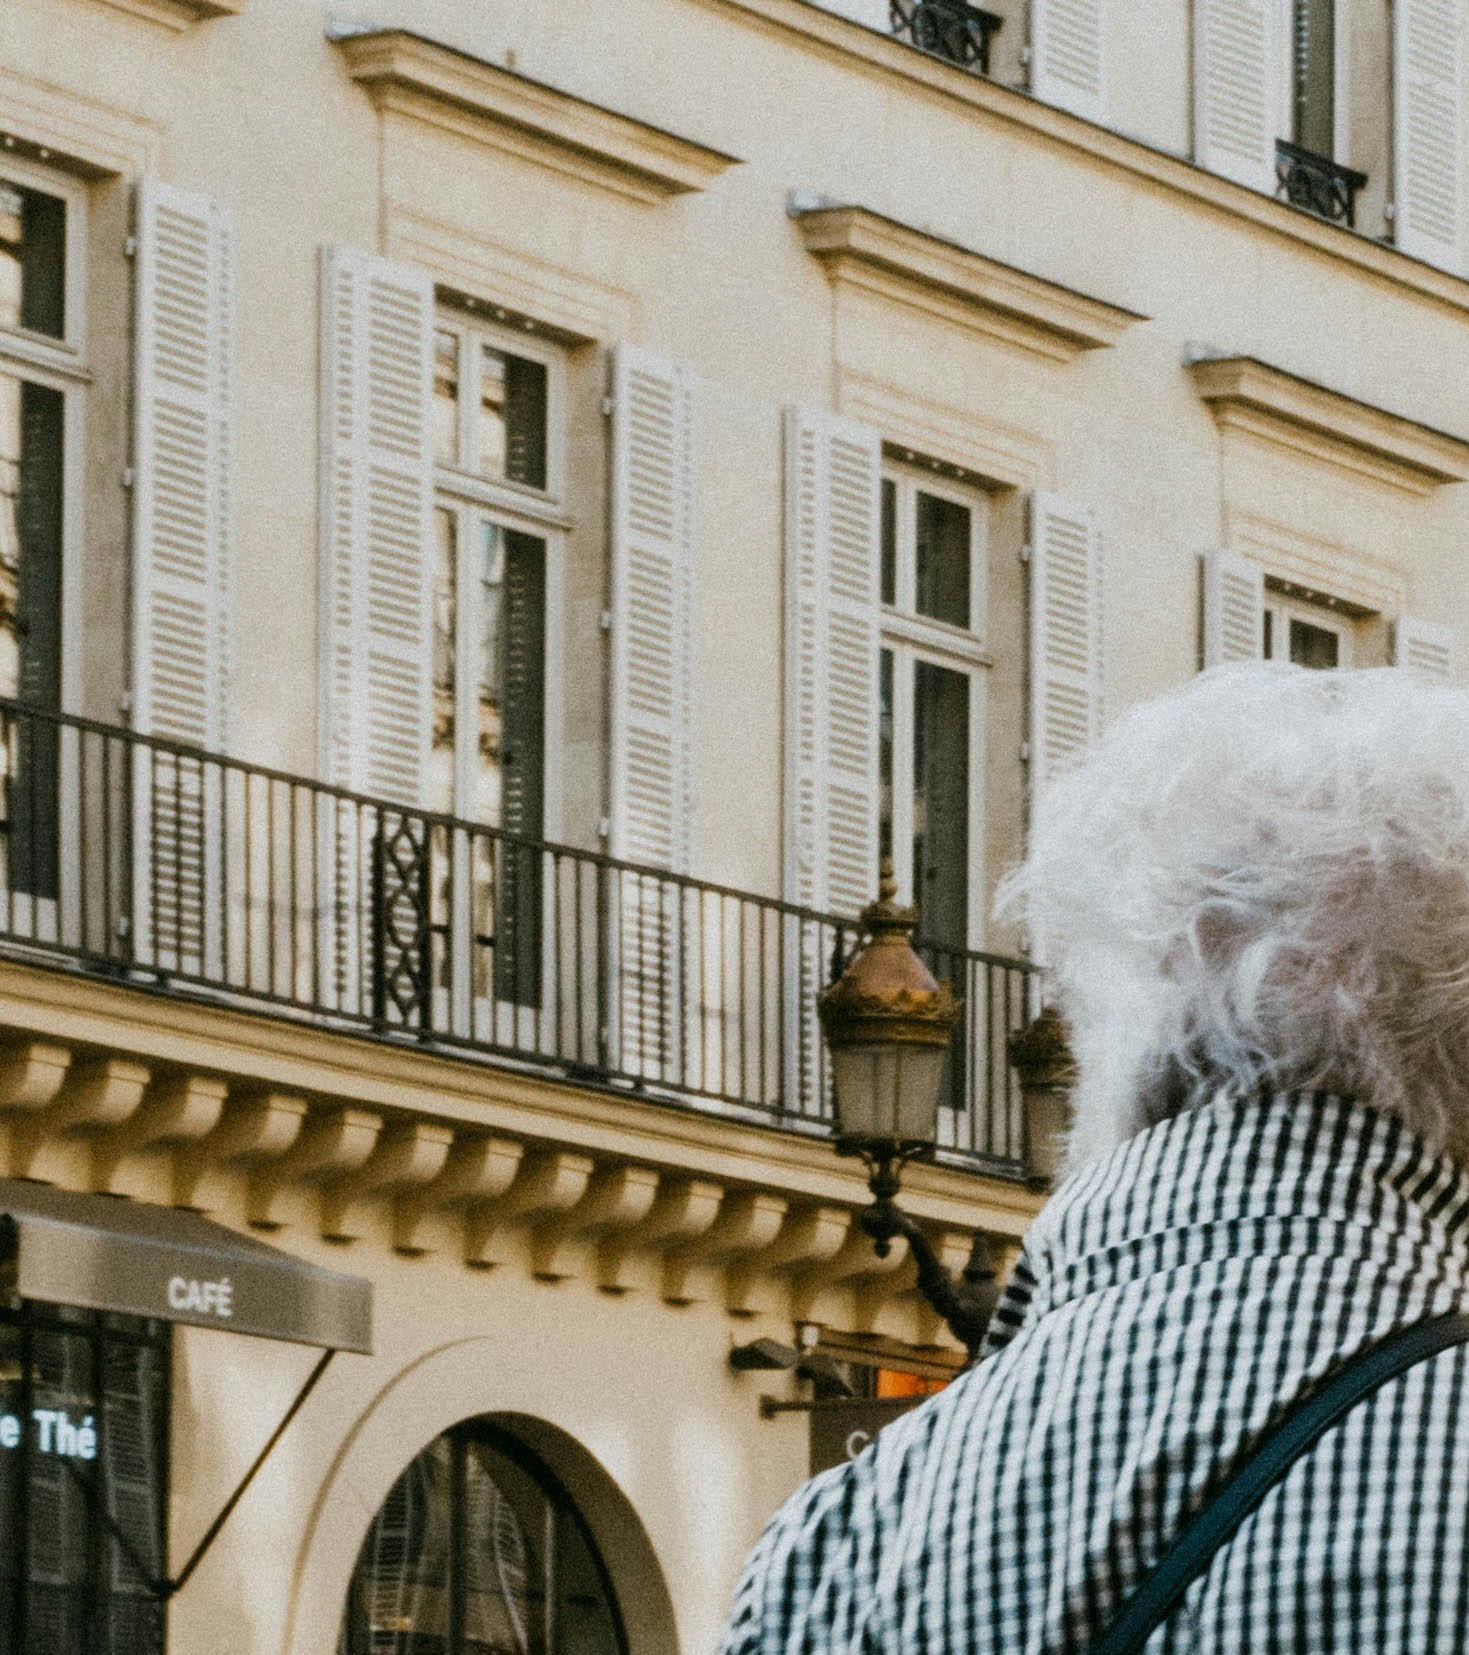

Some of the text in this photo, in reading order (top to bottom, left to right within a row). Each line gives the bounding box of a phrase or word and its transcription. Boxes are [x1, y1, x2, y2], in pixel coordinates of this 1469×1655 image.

[168, 1276, 233, 1317] CAFÉ
[0, 1409, 97, 1460] e Thé
